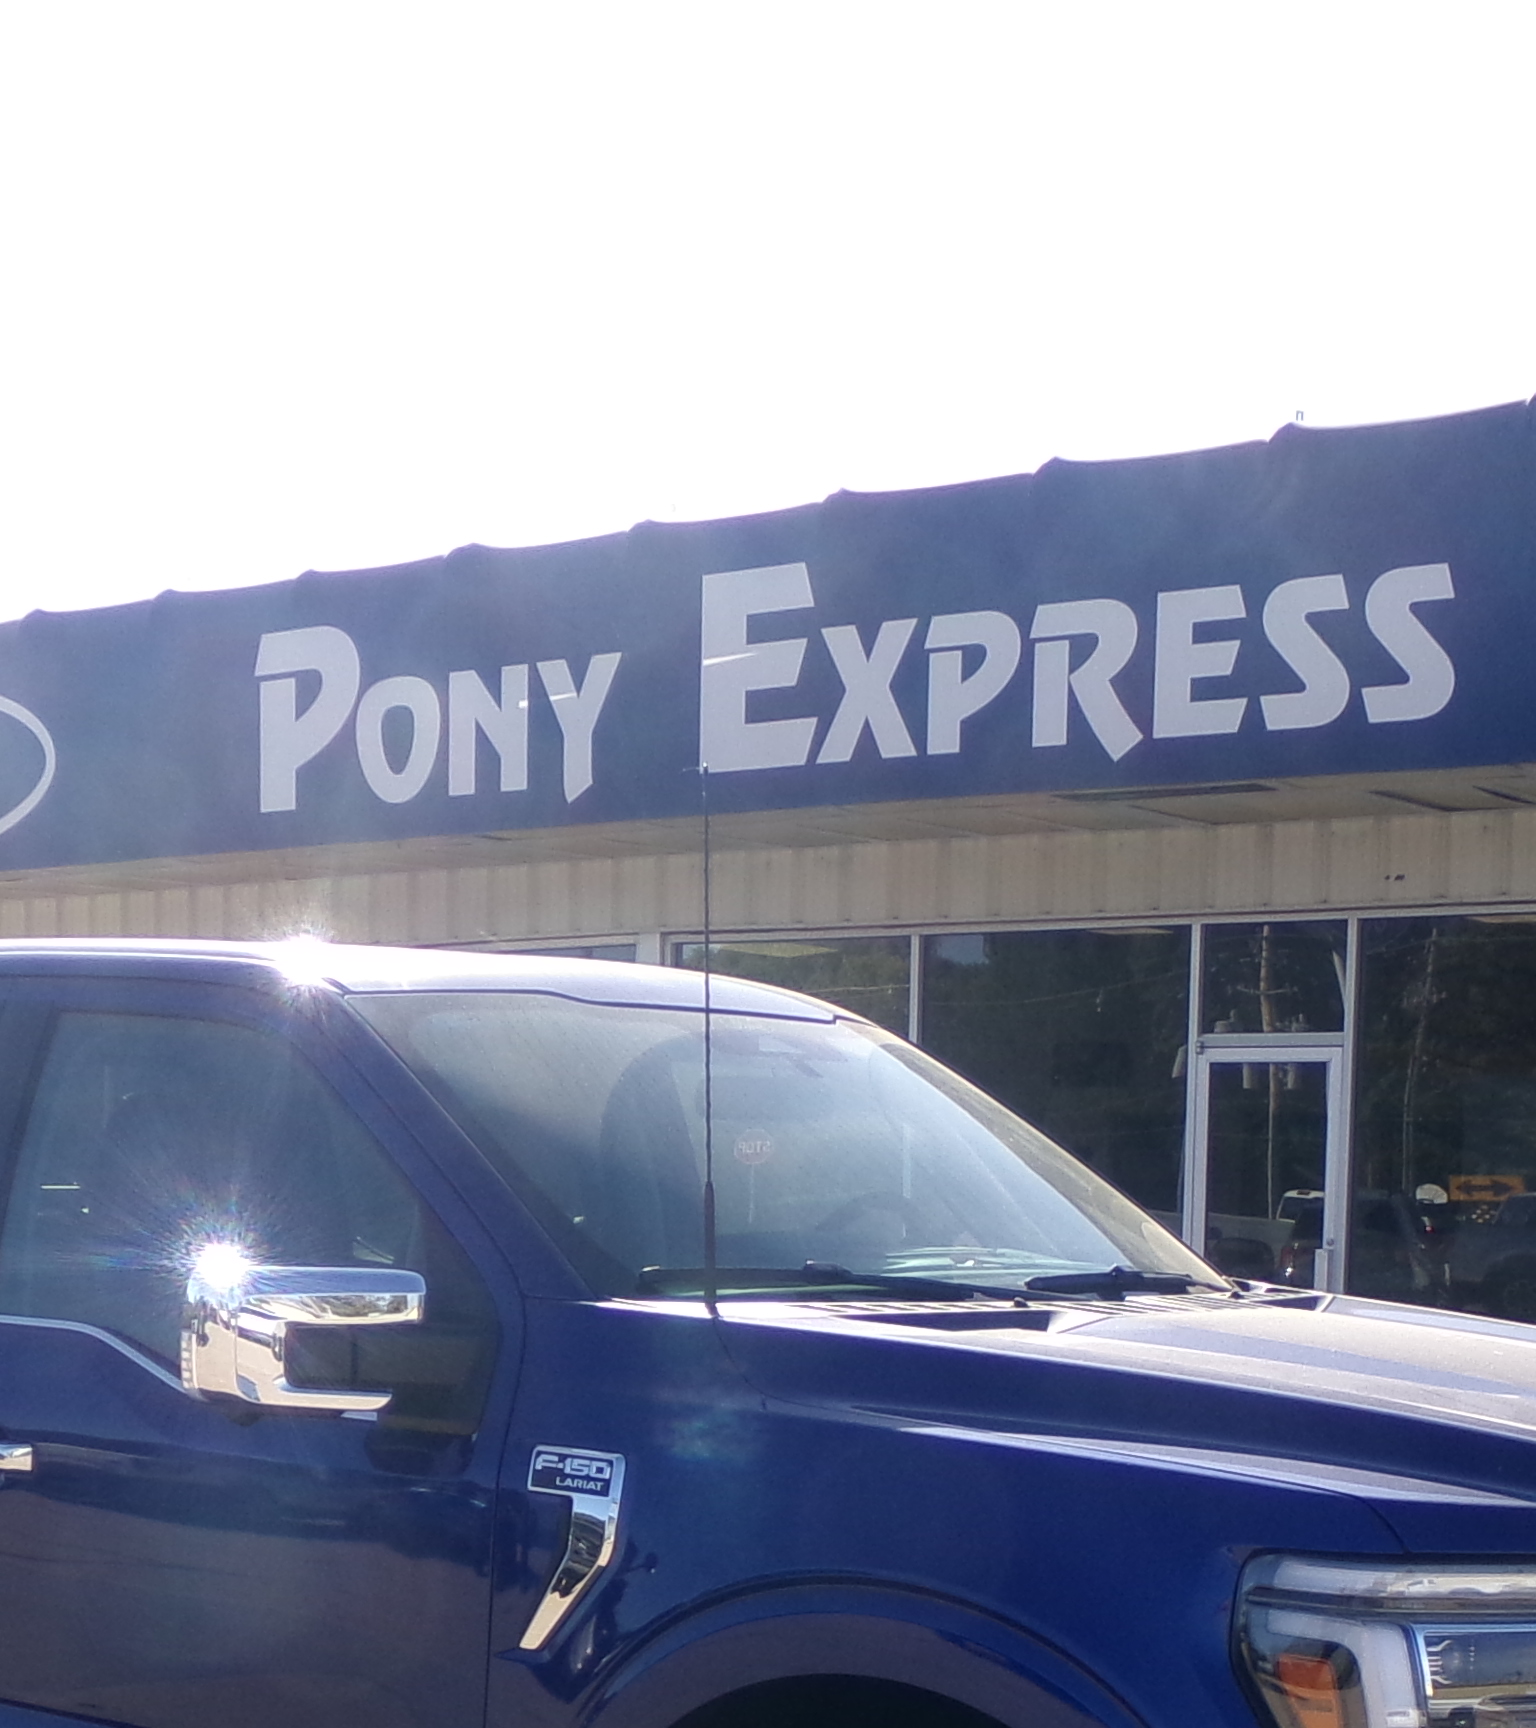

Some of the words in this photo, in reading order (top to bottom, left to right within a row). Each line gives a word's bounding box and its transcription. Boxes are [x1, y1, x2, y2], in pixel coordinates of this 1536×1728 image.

[254, 624, 622, 813] PONY
[699, 561, 1456, 775] EXPRESS
[535, 1454, 611, 1479] F-150
[556, 1476, 604, 1491] LARIAT
